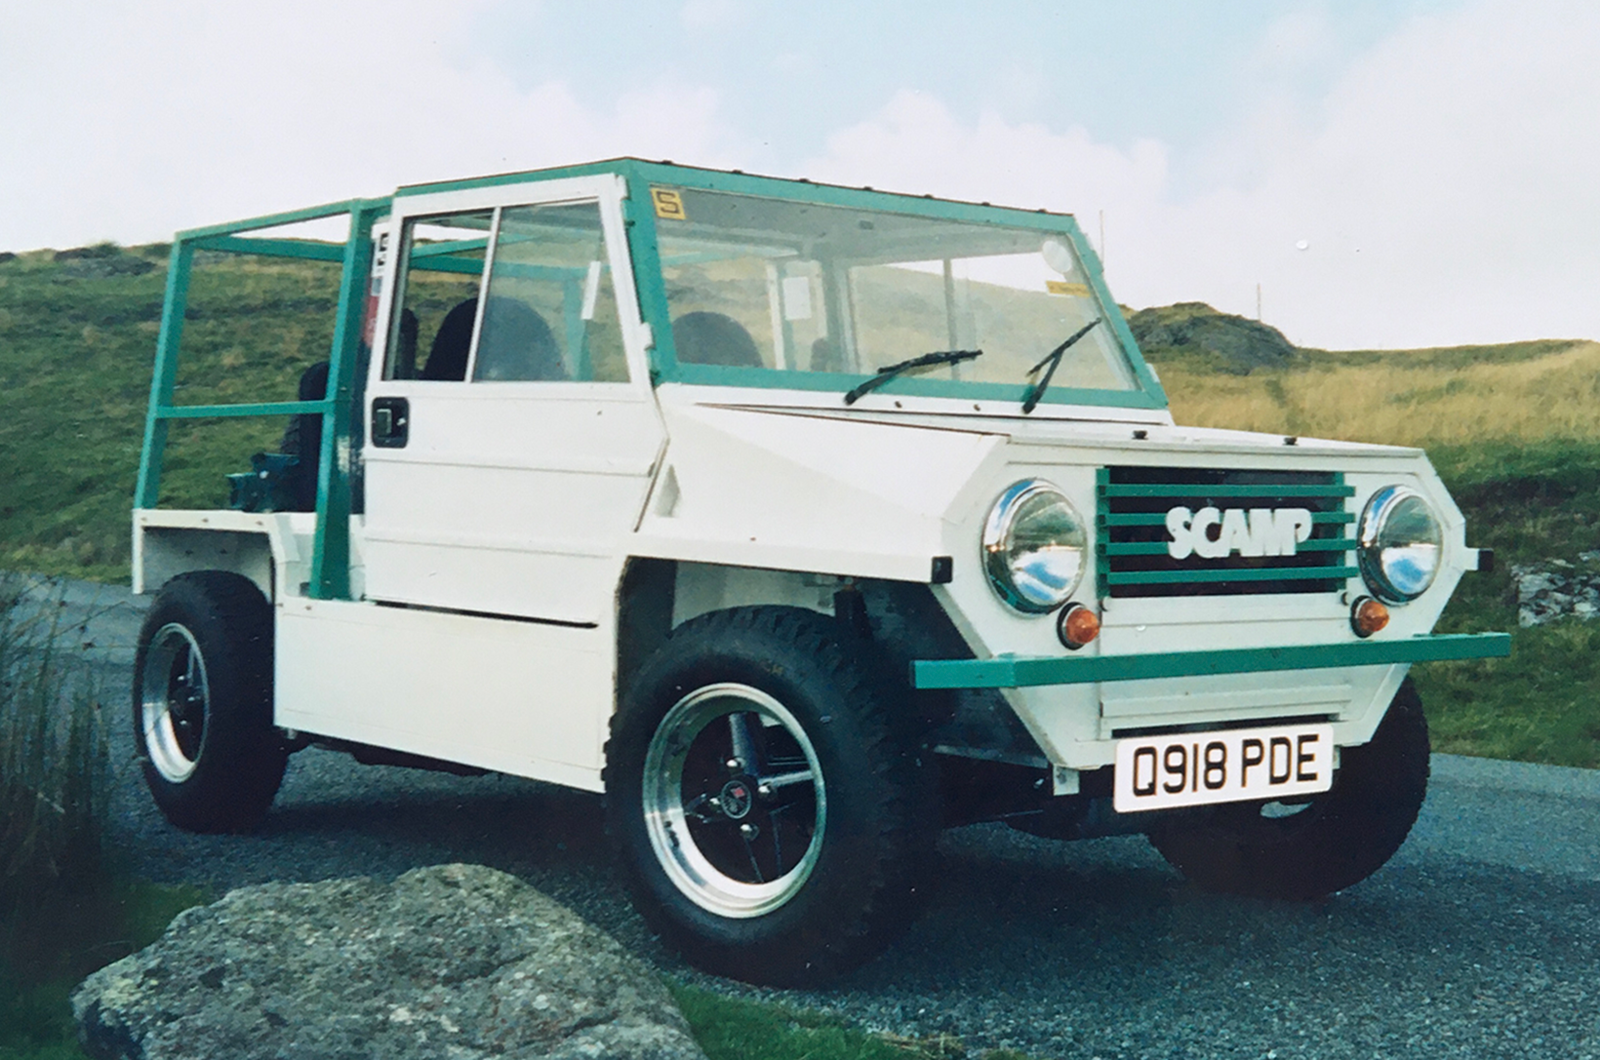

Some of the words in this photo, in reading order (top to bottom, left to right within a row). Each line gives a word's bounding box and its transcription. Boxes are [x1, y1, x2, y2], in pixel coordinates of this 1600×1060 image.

[656, 191, 680, 214] S
[1165, 506, 1313, 560] SCAMP
[1133, 741, 1228, 797] Q918
[1241, 733, 1319, 787] PDE
